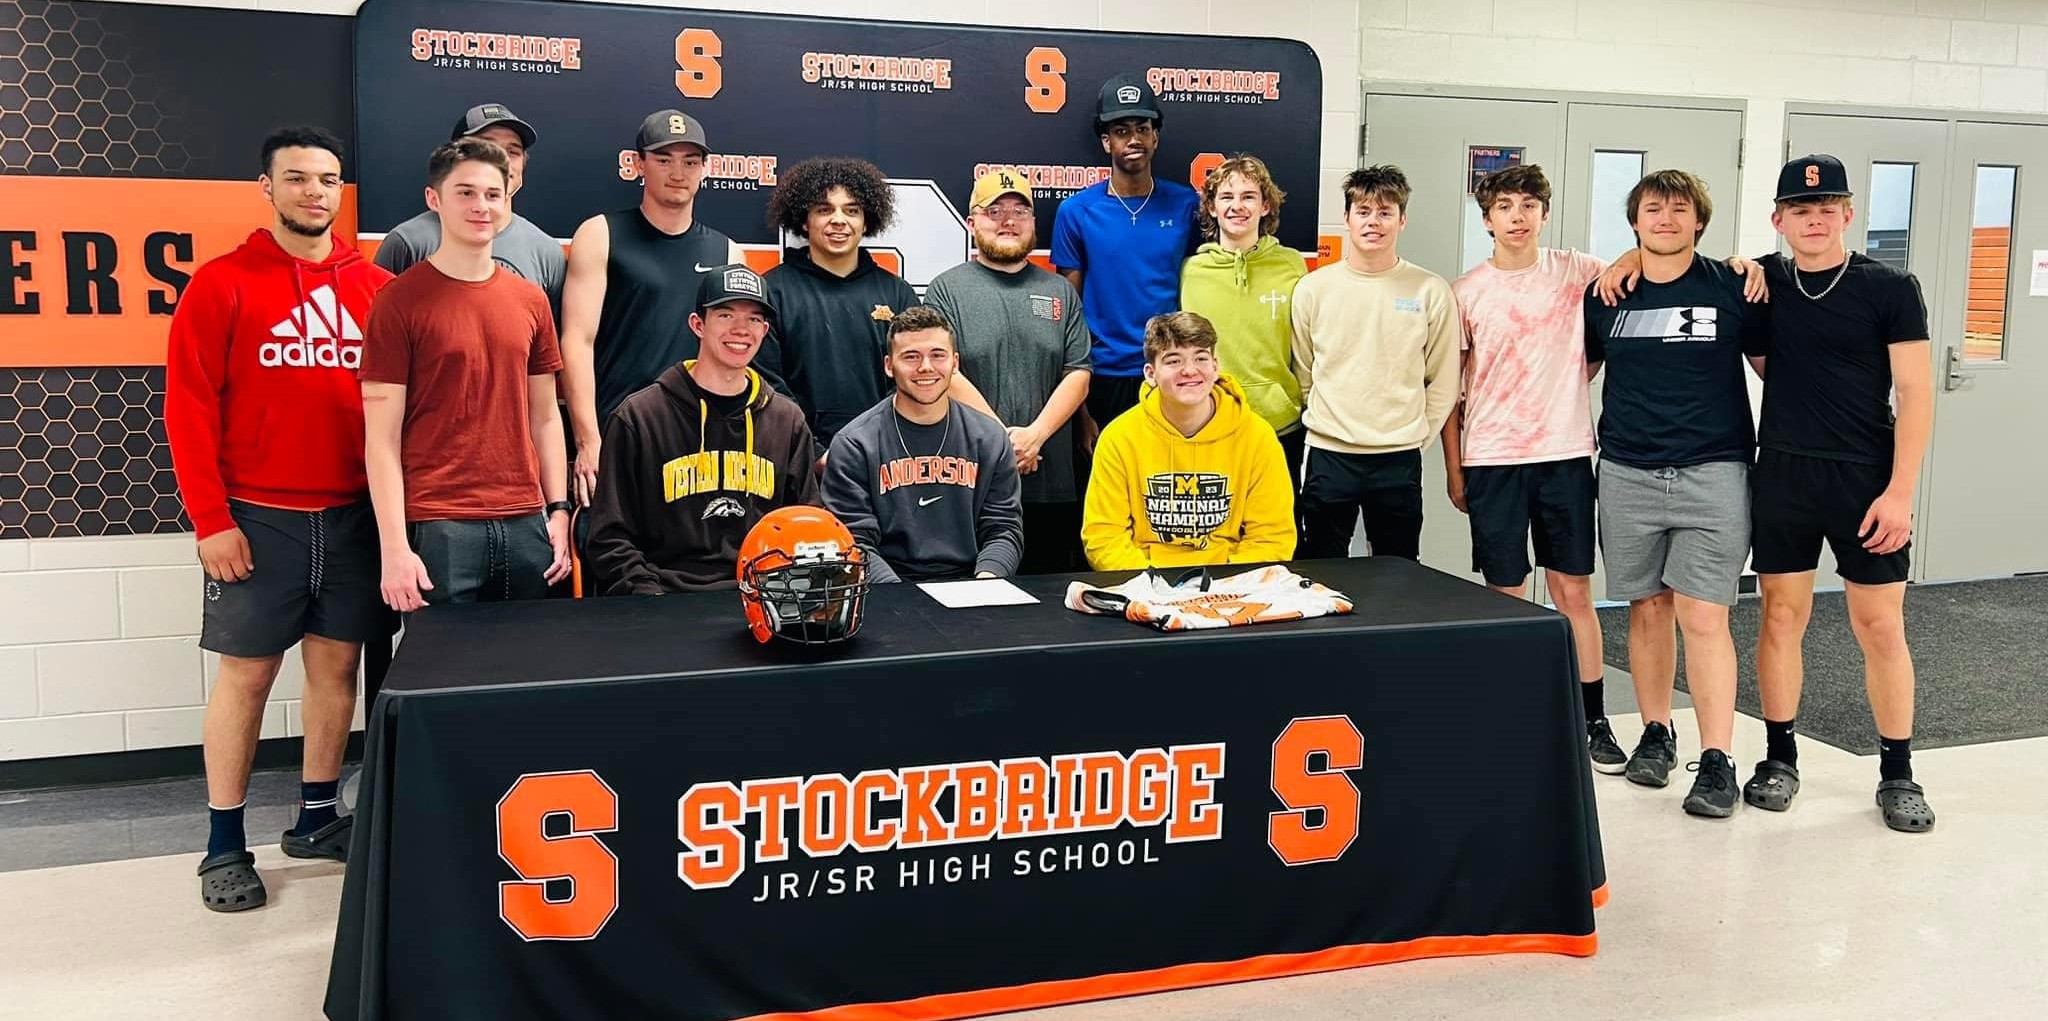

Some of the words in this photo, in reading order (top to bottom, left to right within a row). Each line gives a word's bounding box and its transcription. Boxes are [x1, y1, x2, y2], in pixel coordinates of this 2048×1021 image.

[412, 29, 581, 70] STOCKBRIDGE
[675, 28, 722, 98] S
[434, 58, 470, 69] JR/SR
[476, 60, 506, 71] HIGH
[512, 62, 560, 74] SCHOOL
[802, 52, 951, 89] STOCKBRIDGE
[1025, 47, 1067, 113] S
[821, 79, 854, 89] JR/SR
[859, 81, 885, 91] HIGH
[890, 83, 933, 93] SCHOOL
[1147, 67, 1280, 99] STOCKBRIDGE
[1162, 92, 1192, 102] JR/SR
[1196, 93, 1220, 103] HIGH
[1224, 94, 1263, 104] SCHOOL
[668, 115, 687, 135] S
[619, 150, 777, 186] SRIDGE
[974, 164, 1112, 189] CKBRIDG
[999, 173, 1015, 188] LA
[1805, 165, 1820, 187] S
[713, 180, 758, 191] SCHOOL
[1033, 190, 1050, 199] IGH
[259, 338, 363, 369] adida
[723, 450, 775, 500] MICIGAN
[880, 456, 978, 495] ANDERSON
[1158, 486, 1170, 494] 20
[1175, 475, 1200, 495] M
[1205, 486, 1218, 494] 23
[1148, 498, 1229, 513] NATIONAL
[1149, 512, 1229, 527] HAMPION
[1268, 714, 1364, 867] S
[678, 742, 1226, 889] STOCKBRIDGE
[496, 769, 619, 942] S
[753, 865, 875, 902] JR/SR
[900, 853, 992, 888] HIGH
[1013, 838, 1160, 875] SCHOOL
